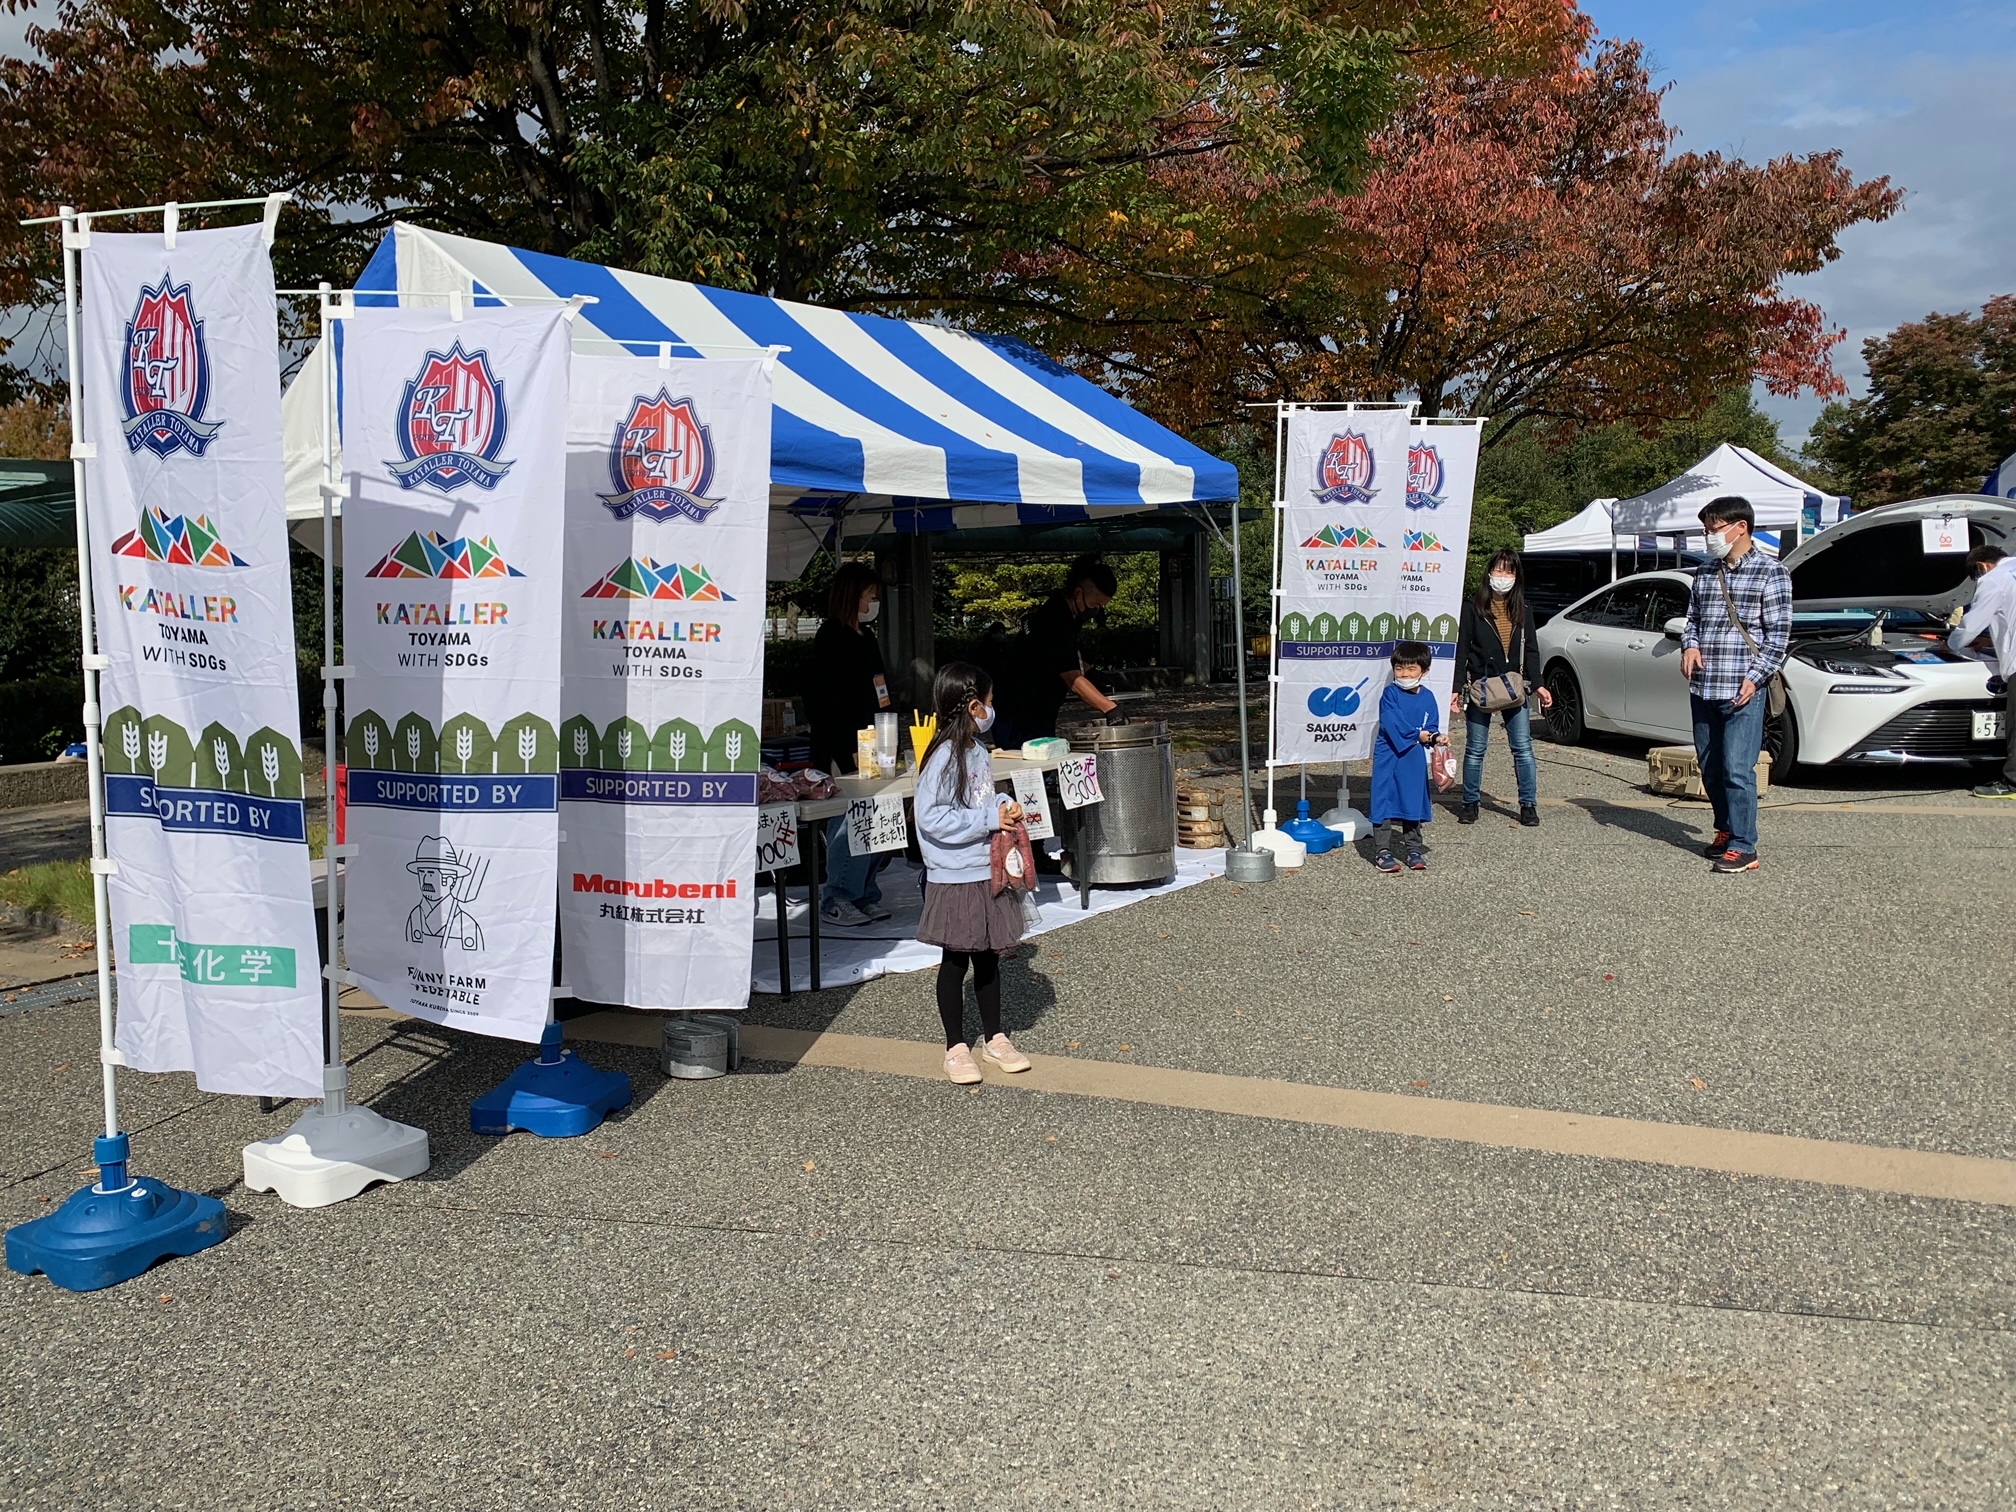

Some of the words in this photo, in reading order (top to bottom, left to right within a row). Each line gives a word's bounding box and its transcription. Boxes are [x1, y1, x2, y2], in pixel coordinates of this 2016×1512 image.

[130, 414, 167, 448] KATALLER
[169, 416, 200, 453] TOYAMA
[407, 455, 454, 486] KATALLER
[458, 458, 492, 487] TOYAMA
[620, 489, 667, 517] KATALLER
[670, 492, 700, 519] TOYAMA
[1306, 559, 1378, 571] KATALLER
[1401, 561, 1441, 573] ALLER
[1317, 583, 1341, 591] WITH
[1344, 583, 1368, 591] SDGs
[1324, 573, 1359, 581] TOYAMA
[1410, 584, 1430, 592] SDGs
[118, 584, 239, 623] KATALLER
[376, 602, 509, 625] KATALLER
[159, 623, 209, 645] TOYAMA
[408, 632, 472, 646] TOYAMA
[593, 620, 721, 642] KATALLER
[142, 645, 187, 666] WITH
[189, 652, 227, 671] SDGs
[398, 653, 438, 667] WITH
[444, 653, 489, 667] SDGs
[623, 646, 687, 660] TOYAMA
[1296, 645, 1361, 656] SUPPORTED
[1366, 646, 1381, 656] BY
[612, 664, 653, 677] WITH
[659, 665, 703, 678] SDGs
[1306, 723, 1357, 733] SAKURA
[1314, 733, 1347, 743] PAXX
[377, 780, 480, 803] SUPPORTED
[492, 785, 522, 804] BY
[586, 777, 691, 798] SUPPORTED
[702, 781, 728, 799] BY
[1068, 775, 1096, 805] 300
[249, 806, 271, 829] BY
[758, 810, 791, 831] まいも
[573, 873, 737, 899] Marubeni
[599, 902, 706, 925] 丸紅株式会社
[407, 966, 444, 985] FUNNY
[449, 974, 486, 990] FARM
